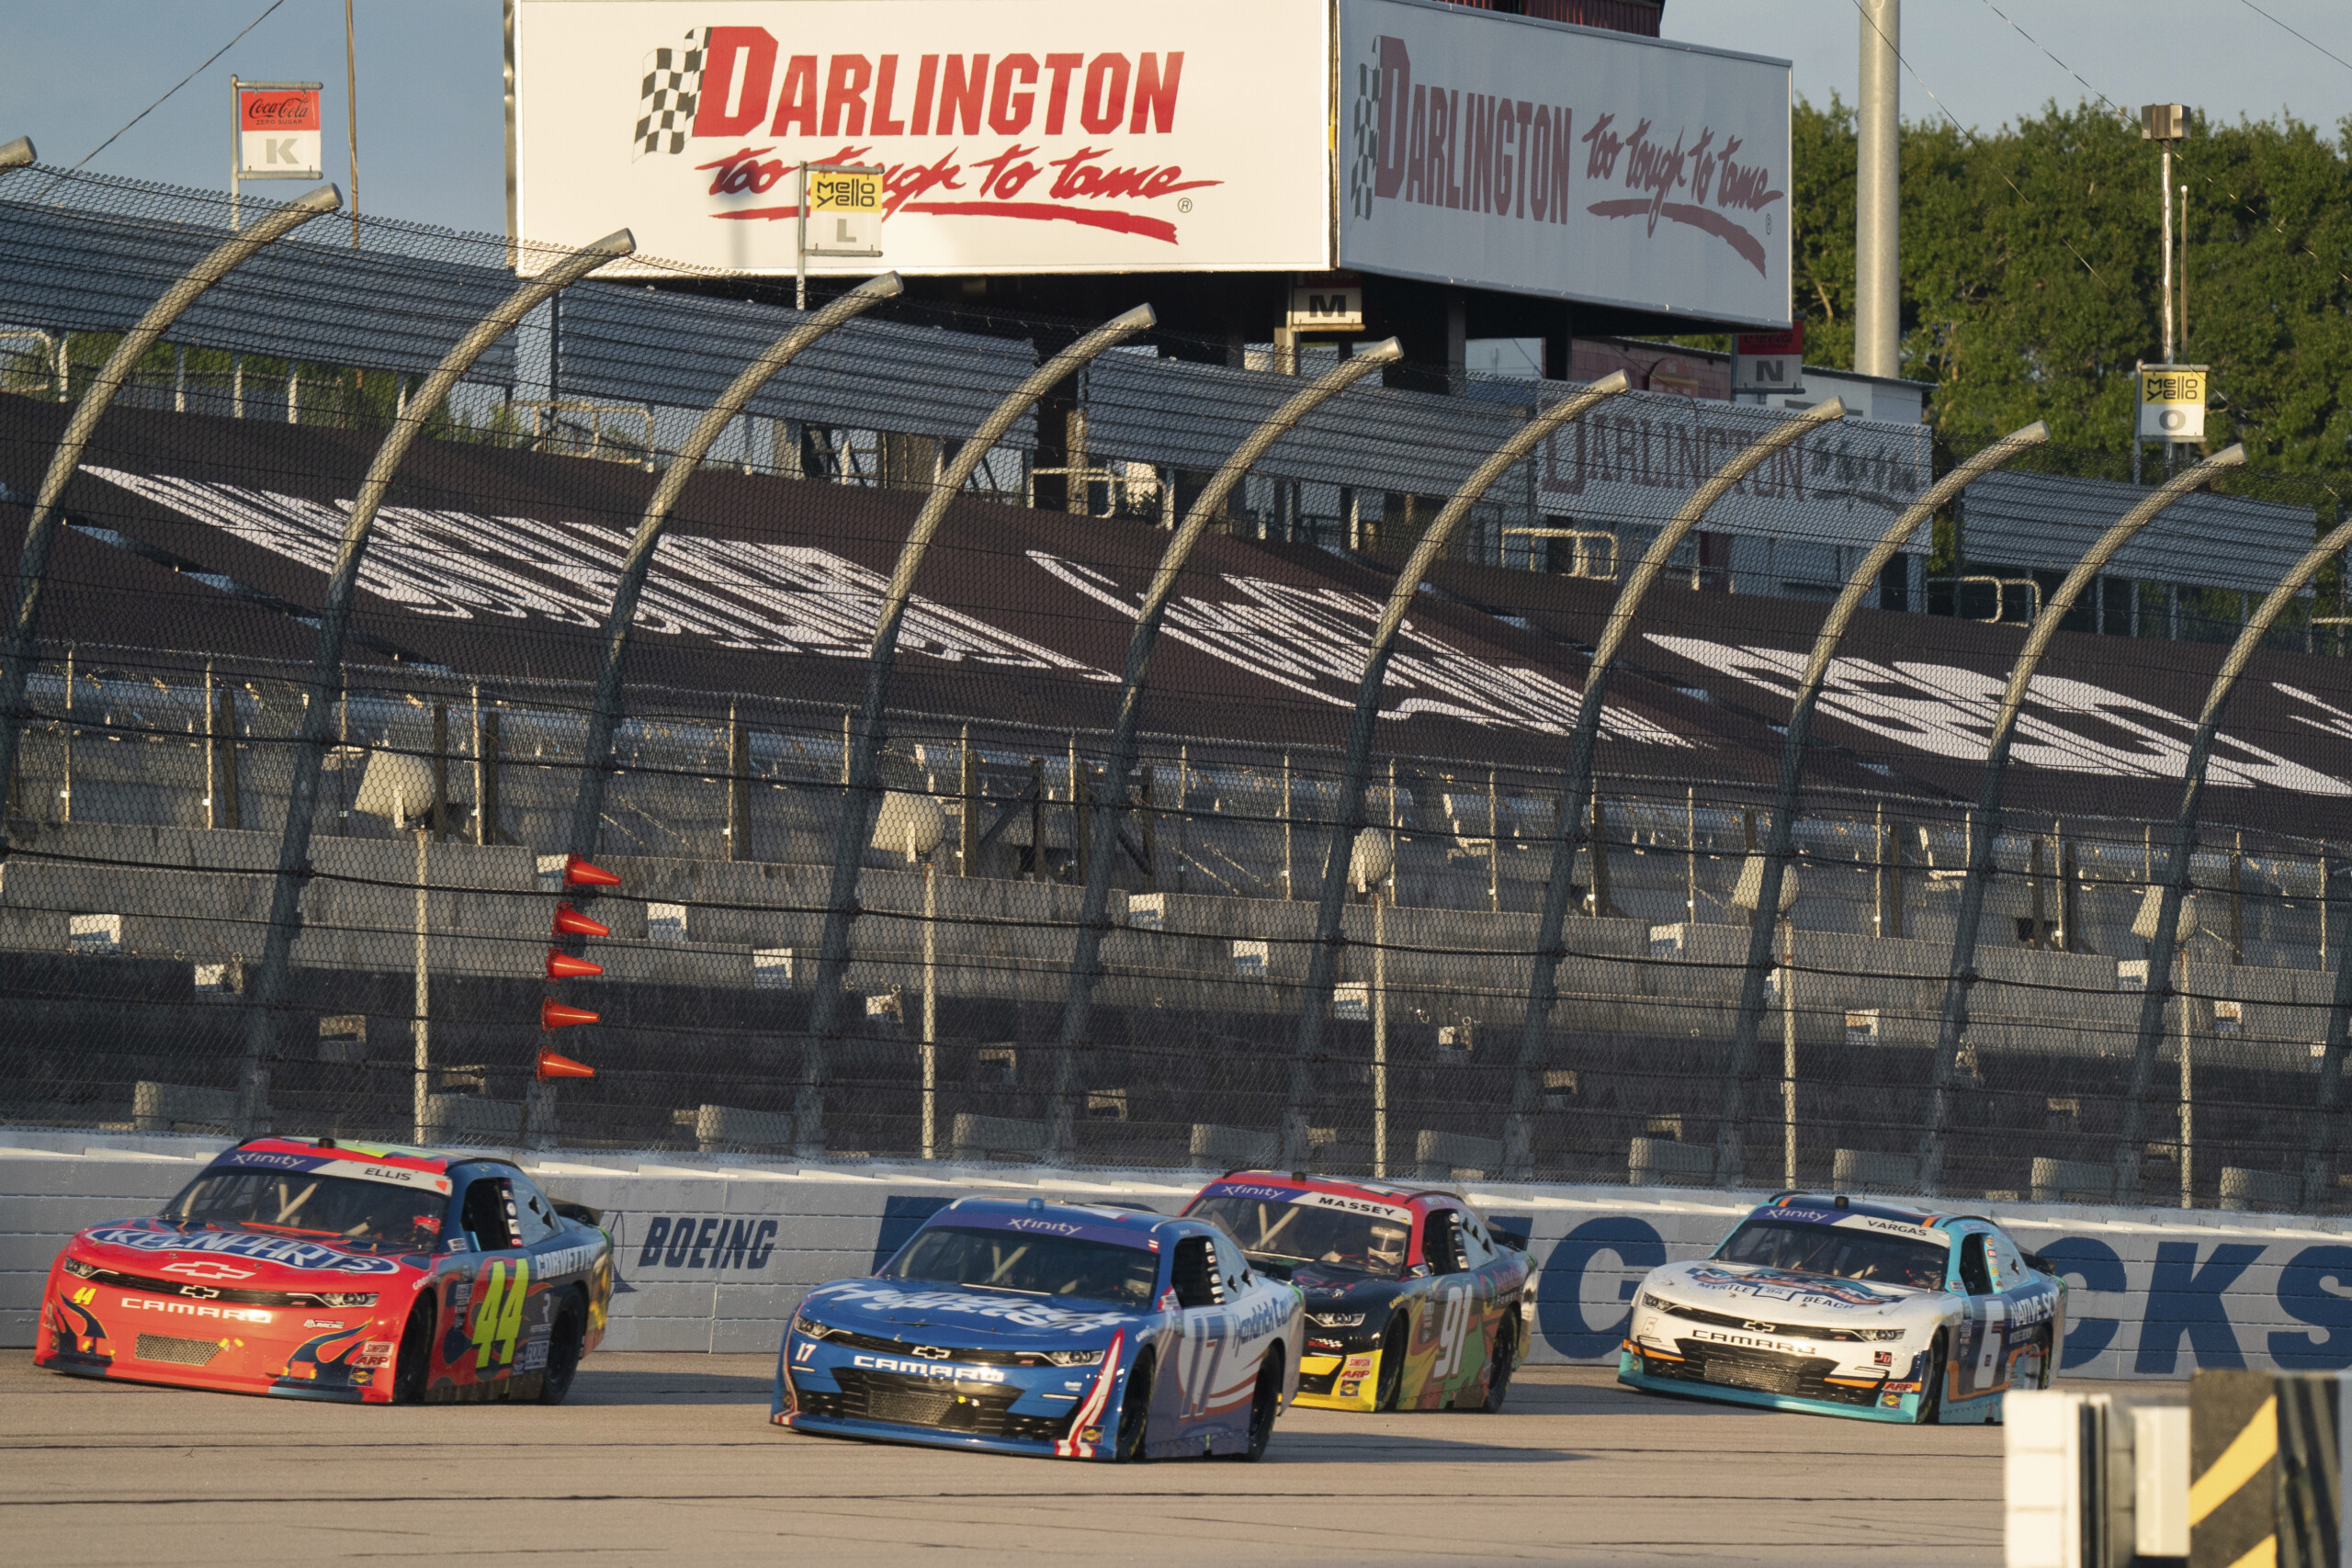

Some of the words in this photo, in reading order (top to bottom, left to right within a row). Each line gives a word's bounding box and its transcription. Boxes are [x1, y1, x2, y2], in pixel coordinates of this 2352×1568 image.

[693, 27, 1184, 137] DARLINGTON
[249, 97, 310, 118] Coca-Cola
[1374, 35, 1572, 225] DARLINGTON
[1581, 112, 1624, 180] too
[1625, 118, 1687, 238] tough
[1688, 126, 1716, 205] to
[1718, 135, 1784, 213] tame
[266, 139, 300, 164] K
[694, 147, 797, 196] too
[970, 145, 1042, 199] to
[1047, 147, 1225, 199] tame
[836, 219, 856, 243] L
[1309, 295, 1346, 318] M
[1756, 360, 1784, 381] N
[2159, 410, 2186, 431] O
[1642, 632, 2352, 796] GEICO
[231, 1152, 307, 1168] xfinity
[364, 1168, 412, 1181] ELLIS
[1221, 1183, 1286, 1200] xfinity
[1318, 1197, 1396, 1216] MASSEY
[1766, 1207, 1828, 1222] xfinity
[1007, 1218, 1082, 1235] xfinity
[1867, 1220, 1928, 1236] VARGAS
[638, 1216, 778, 1269] BOEING
[74, 1287, 96, 1305] 44
[1803, 1295, 1855, 1310] BEACH
[121, 1297, 272, 1324] CAMARO
[471, 1258, 530, 1370] 44
[2010, 1295, 2041, 1328] NATIVE
[1433, 1284, 1472, 1378] 91
[1642, 1316, 1658, 1336] 6
[796, 1342, 817, 1363] 17
[1692, 1329, 1816, 1355] CAMARO
[1974, 1300, 2006, 1390] 6
[355, 1356, 389, 1365] ARP
[1181, 1314, 1228, 1418] 17
[1349, 1357, 1371, 1367] SIMPSON
[1340, 1370, 1371, 1379] ARP
[1884, 1382, 1913, 1392] ARP
